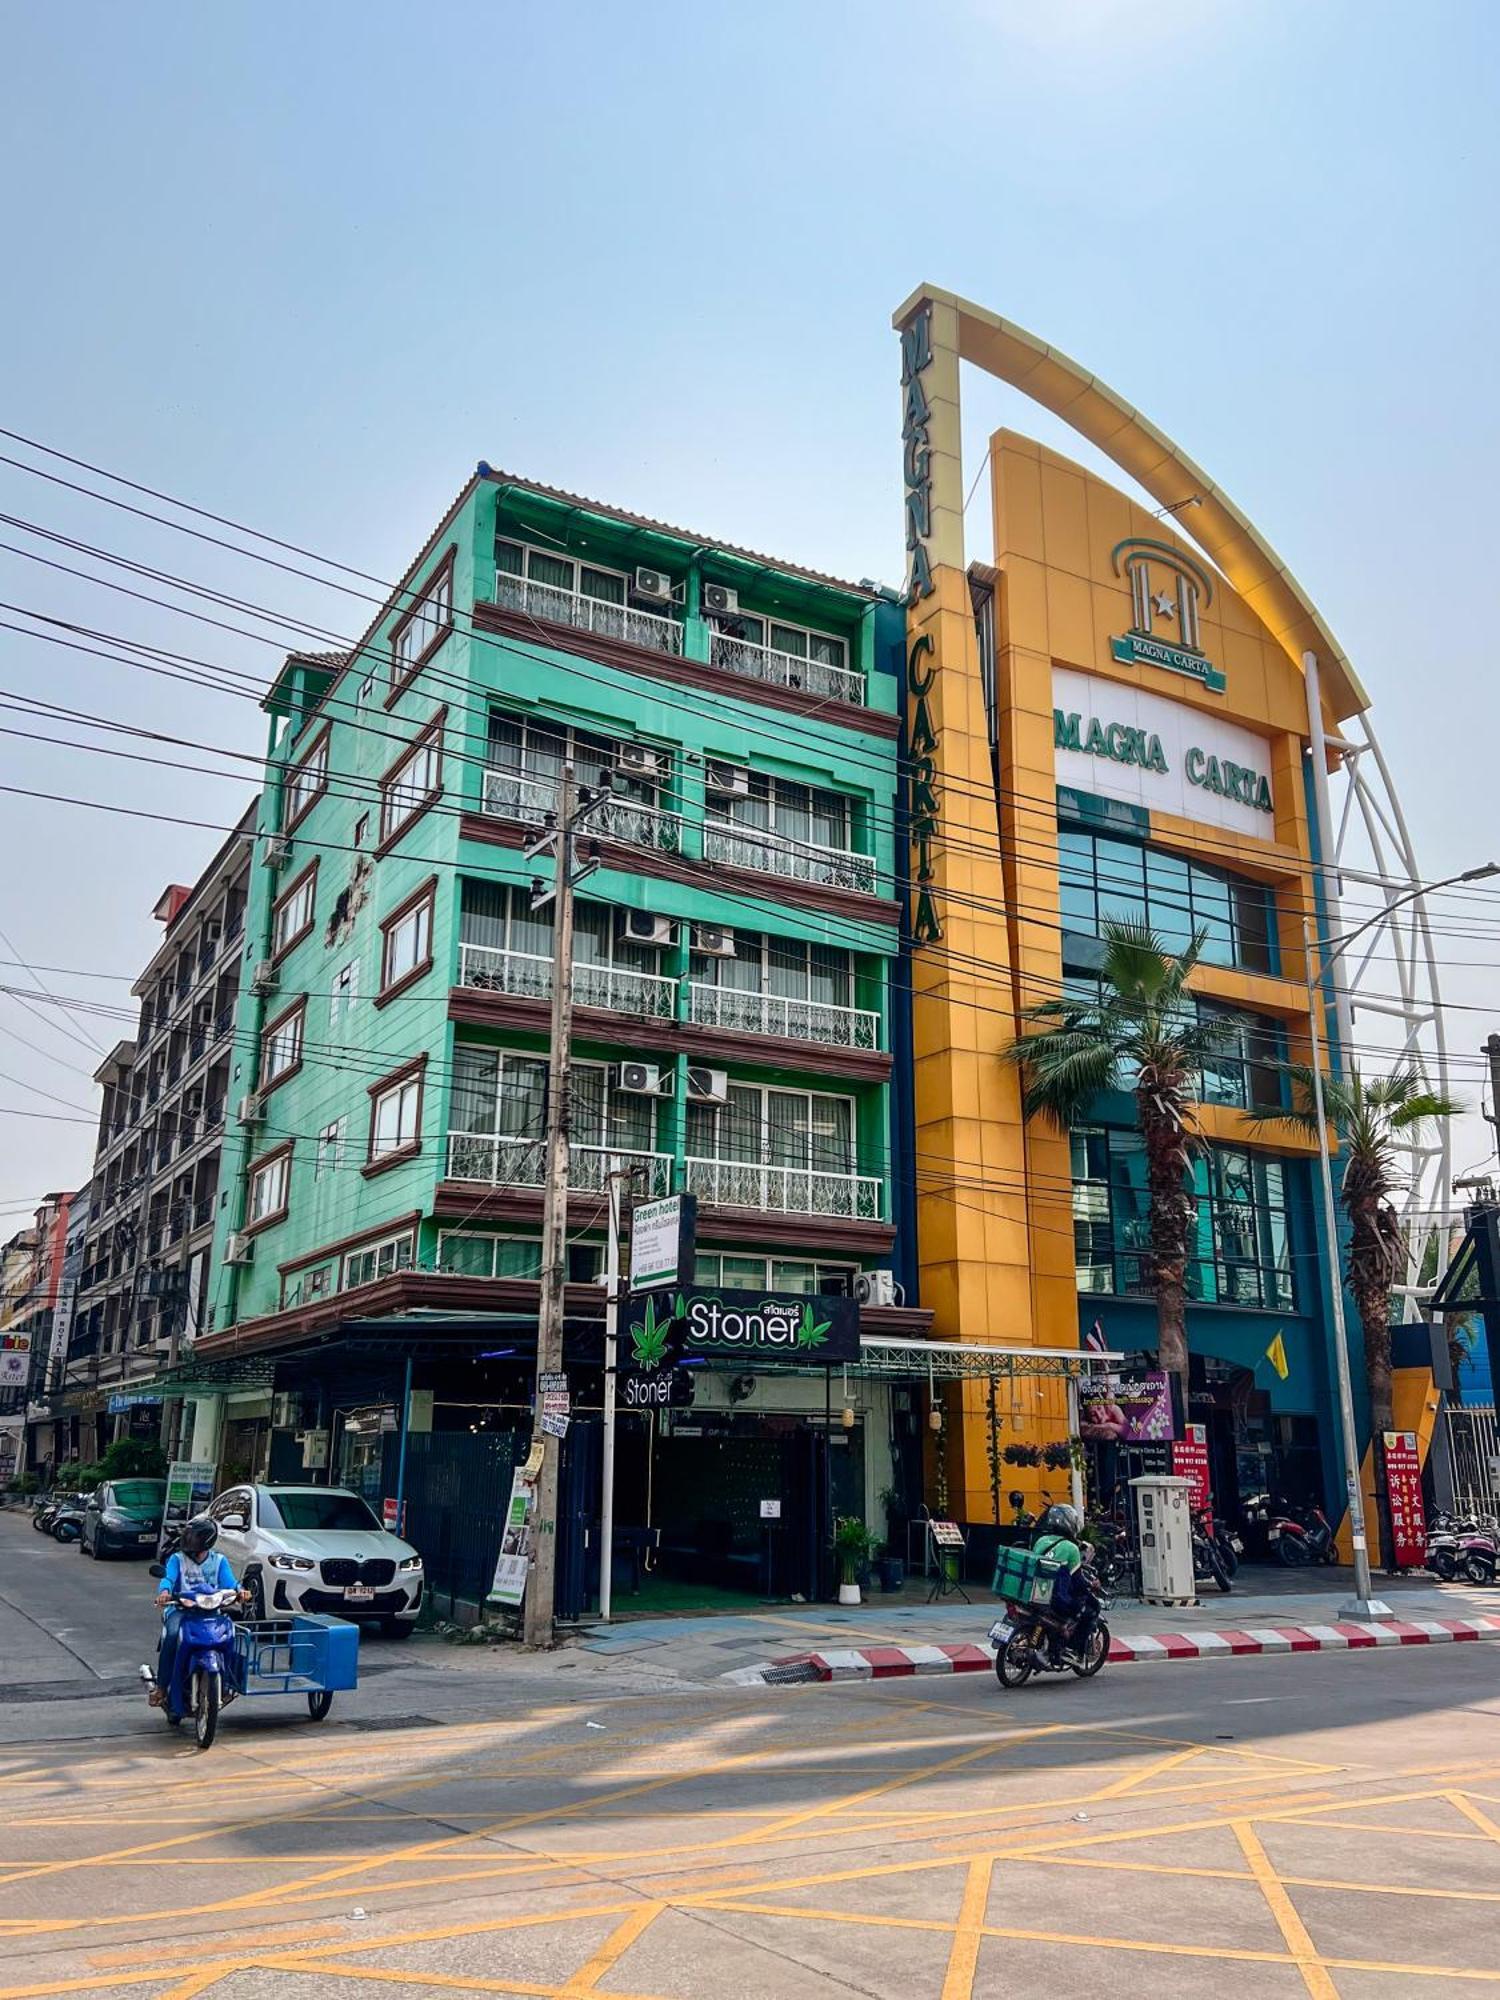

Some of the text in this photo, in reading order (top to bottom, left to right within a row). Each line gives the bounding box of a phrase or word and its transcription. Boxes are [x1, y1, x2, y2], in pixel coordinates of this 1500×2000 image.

[900, 308, 944, 945] MAGNA CARTA
[1132, 640, 1209, 674] MAGNA CARTA
[1053, 708, 1274, 813] MAGNA CARTA
[634, 1207, 657, 1222] Green
[690, 1303, 800, 1343] Stoner
[627, 1378, 673, 1405] Stoner
